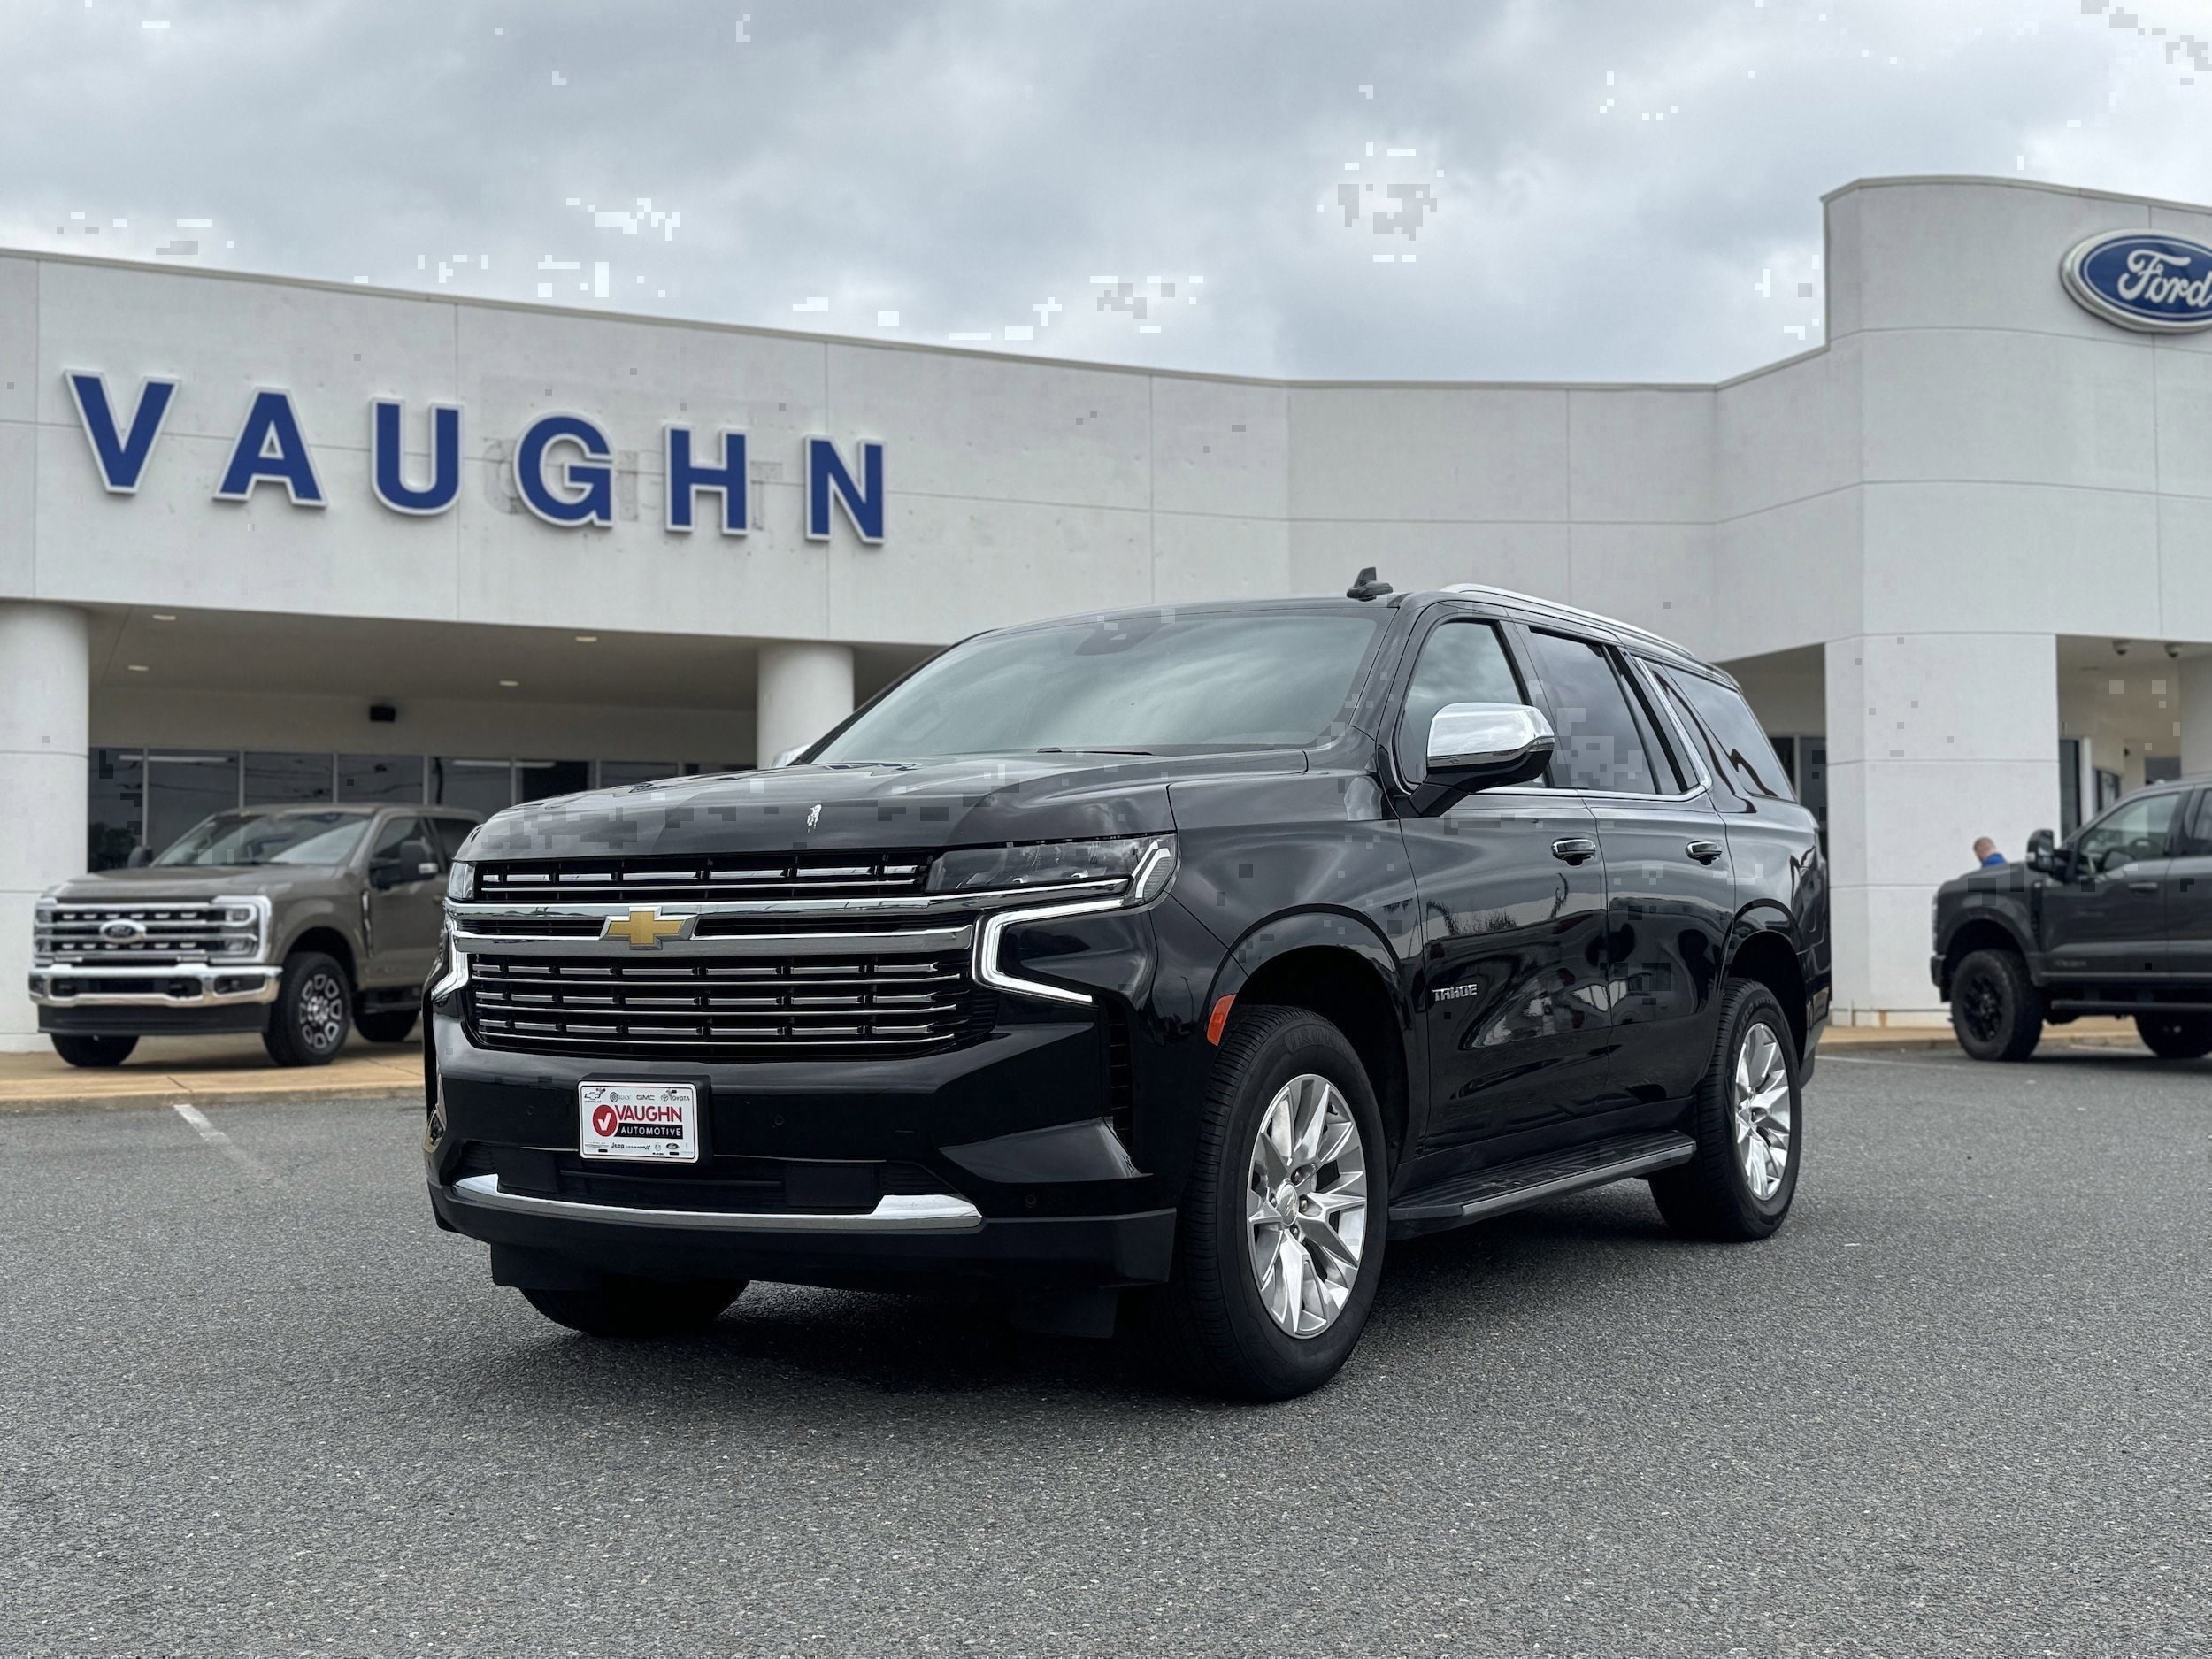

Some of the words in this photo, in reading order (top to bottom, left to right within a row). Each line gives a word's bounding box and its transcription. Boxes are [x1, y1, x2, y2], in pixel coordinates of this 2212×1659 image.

[2117, 248, 2212, 308] Ford
[65, 368, 886, 545] VAUGHN
[1432, 983, 1478, 1002] TAHOE
[614, 1104, 683, 1123] VAUGHN
[620, 1126, 681, 1137] AUTOMOTIVE
